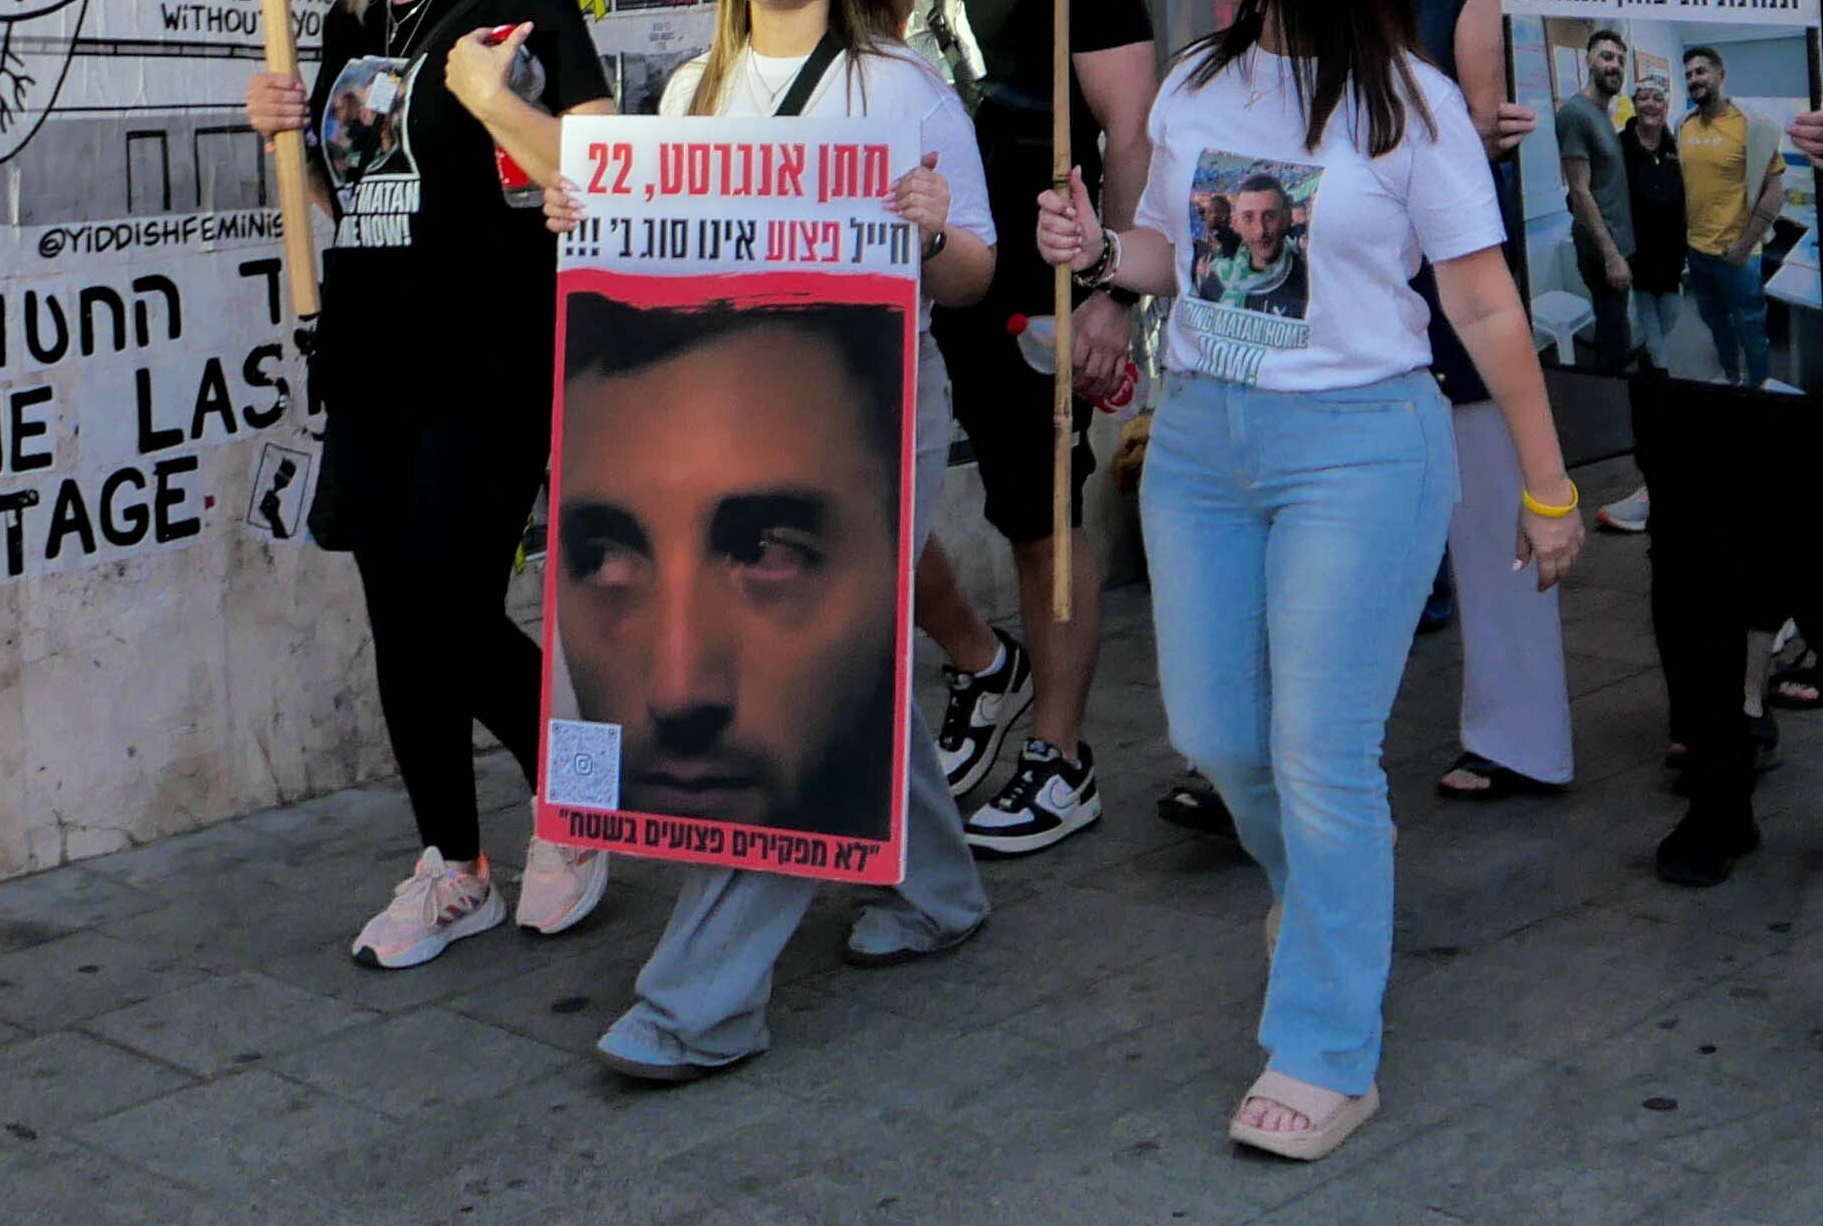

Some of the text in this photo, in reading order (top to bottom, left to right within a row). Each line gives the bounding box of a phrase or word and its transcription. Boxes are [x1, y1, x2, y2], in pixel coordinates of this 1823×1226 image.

[587, 142, 892, 203] מתן אנגרסט, 22
[360, 214, 413, 246] NOW!
[639, 218, 690, 258] סוג
[698, 220, 756, 262] אינו
[764, 220, 842, 262] פצוע
[850, 217, 911, 264] חייל
[1214, 308, 1263, 345] MATAN
[1264, 320, 1309, 350] HOME
[136, 343, 320, 455] LAS
[643, 817, 726, 855] פצועים
[730, 829, 828, 867] מפקירים
